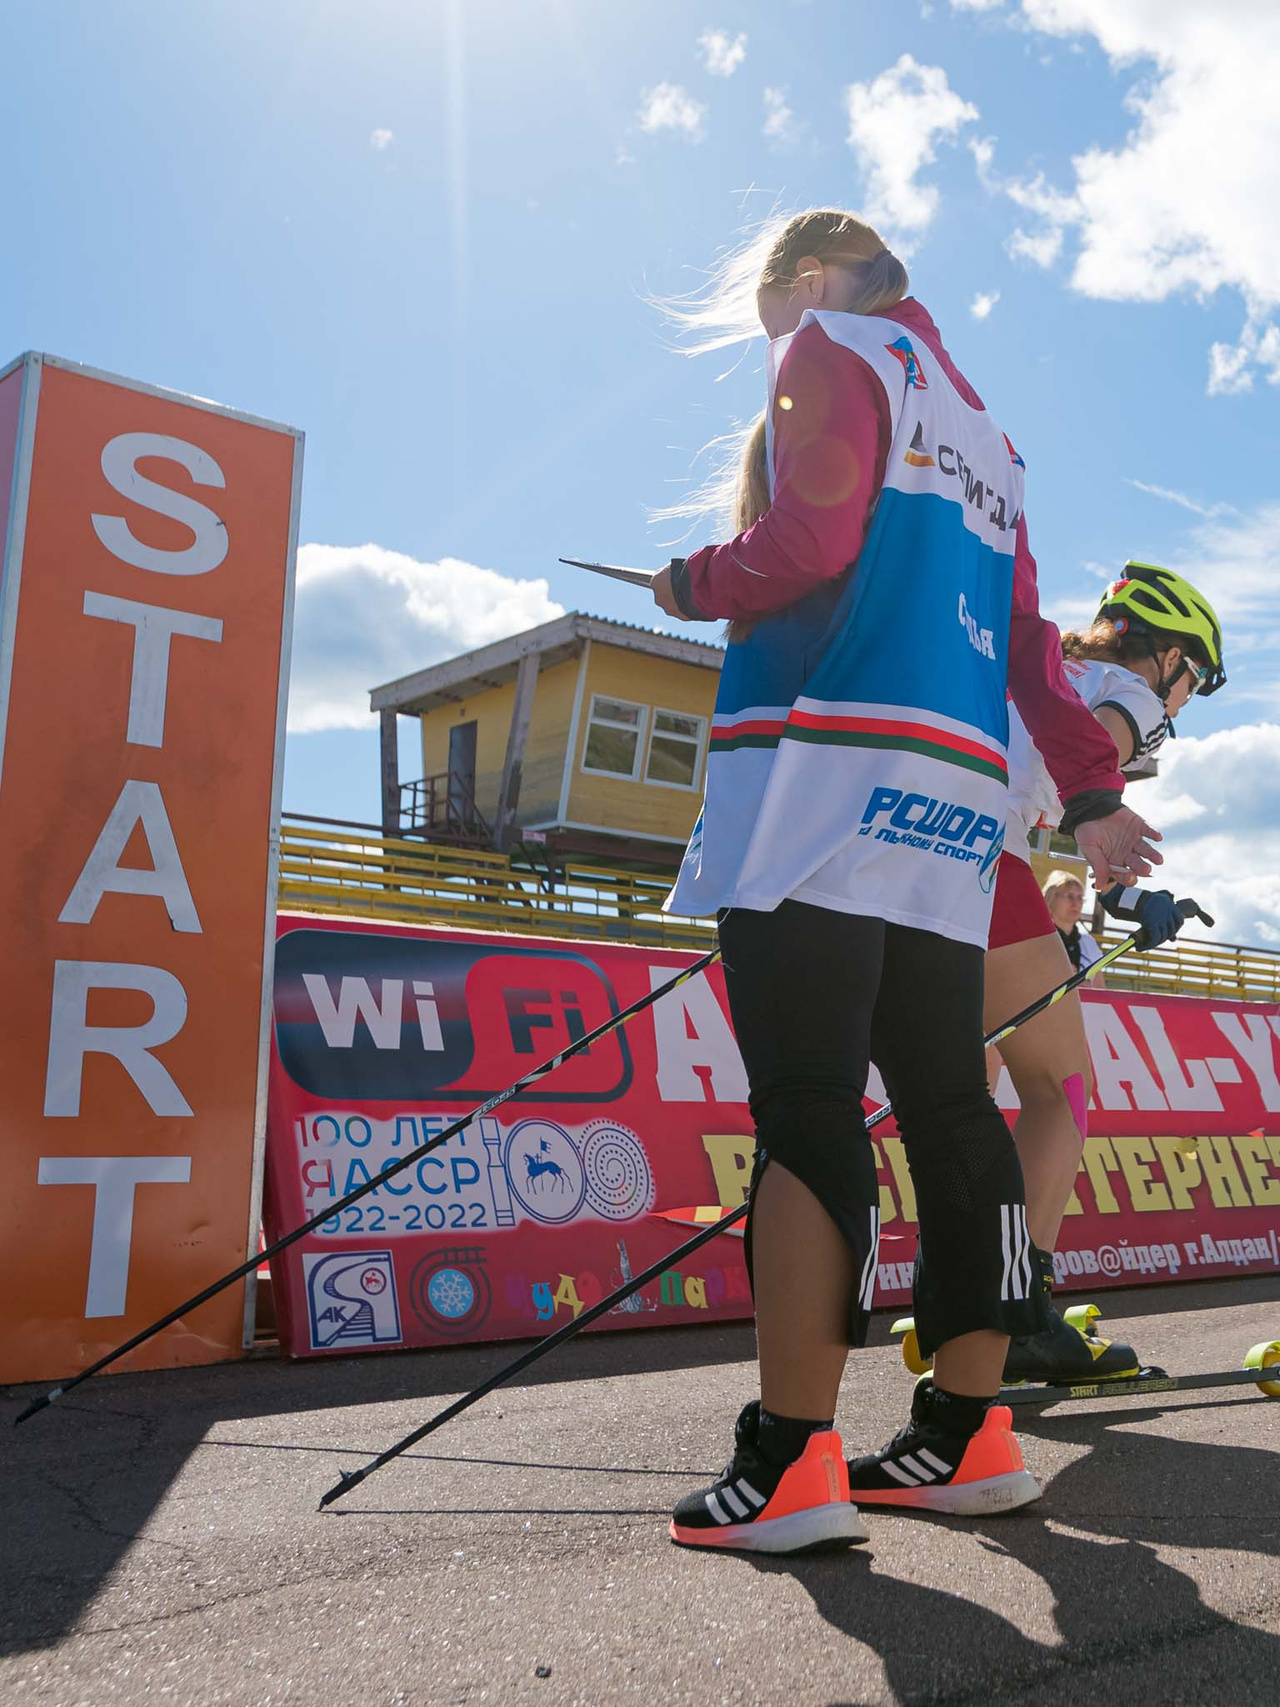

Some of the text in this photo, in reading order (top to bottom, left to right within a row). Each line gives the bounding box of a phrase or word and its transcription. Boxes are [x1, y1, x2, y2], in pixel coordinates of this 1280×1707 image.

[861, 787, 998, 847] РСШОР
[38, 432, 229, 1319] START
[302, 973, 591, 1056] Wi Fi
[295, 1115, 470, 1147] 100 ЛЕТ
[302, 1157, 480, 1197] ЯАССР
[306, 1203, 488, 1234] 1922-2022
[1052, 1240, 1182, 1284] ров@йдер
[1070, 1385, 1099, 1398] START
